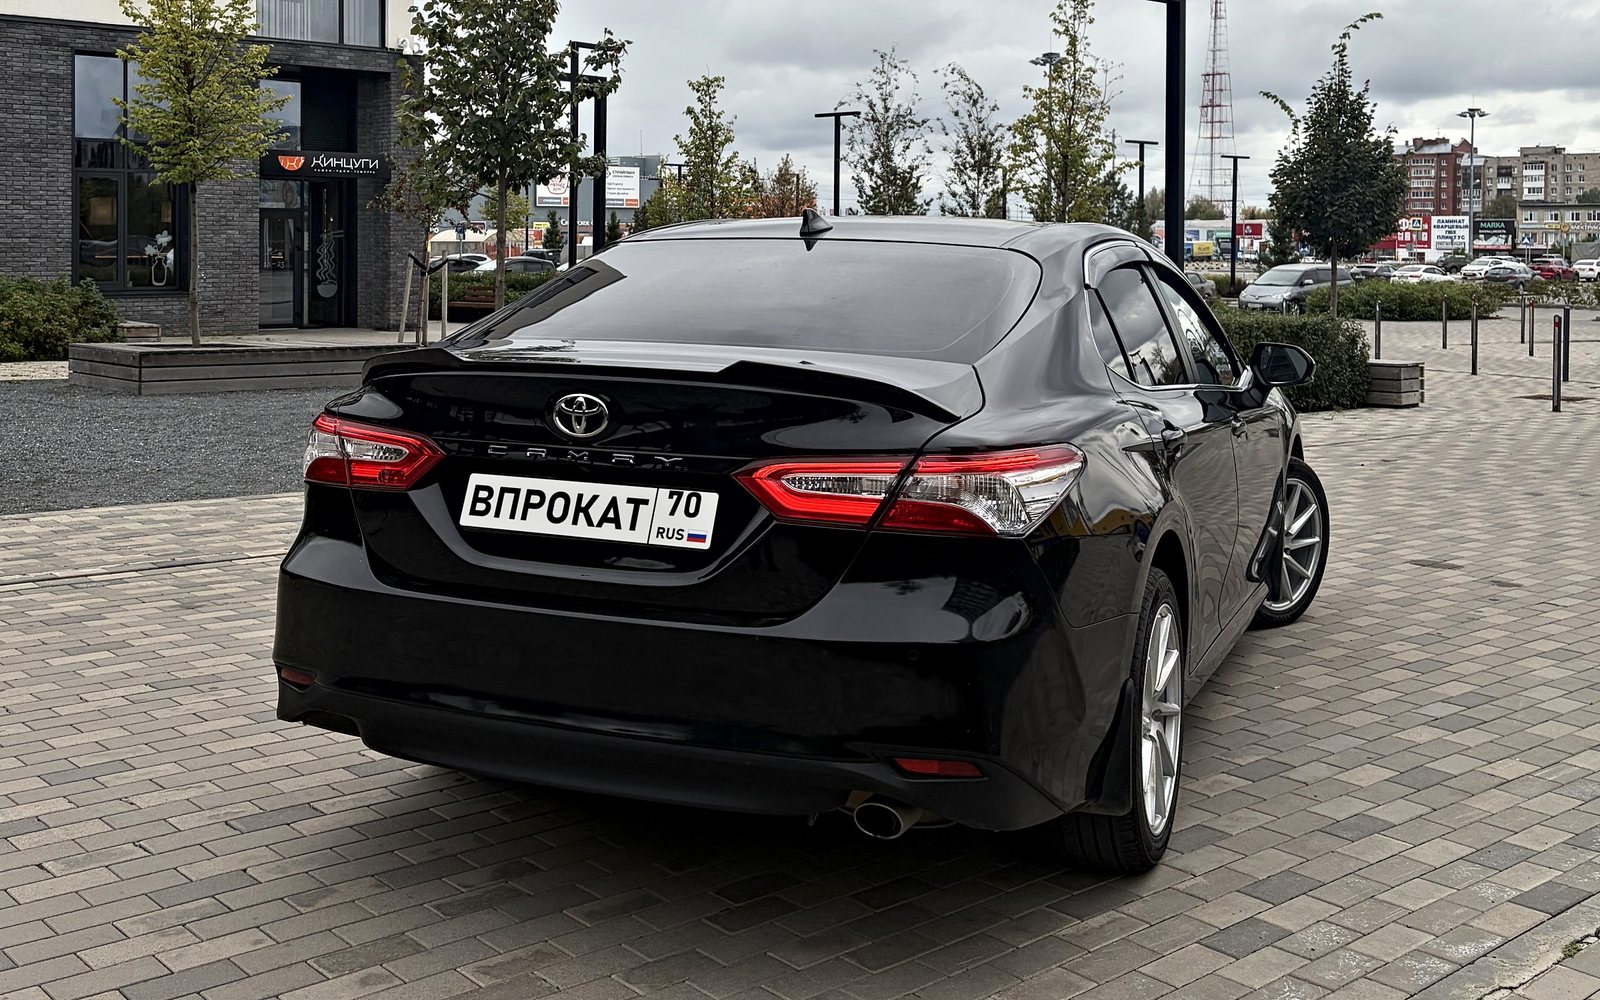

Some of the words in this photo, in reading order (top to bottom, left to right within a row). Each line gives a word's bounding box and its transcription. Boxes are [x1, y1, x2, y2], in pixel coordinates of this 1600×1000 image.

[311, 154, 379, 170] КИНЦУГИ
[487, 444, 683, 466] CAMRY
[468, 484, 649, 531] ВПРОКАТ
[667, 490, 702, 518] 70
[655, 527, 684, 541] RUS
